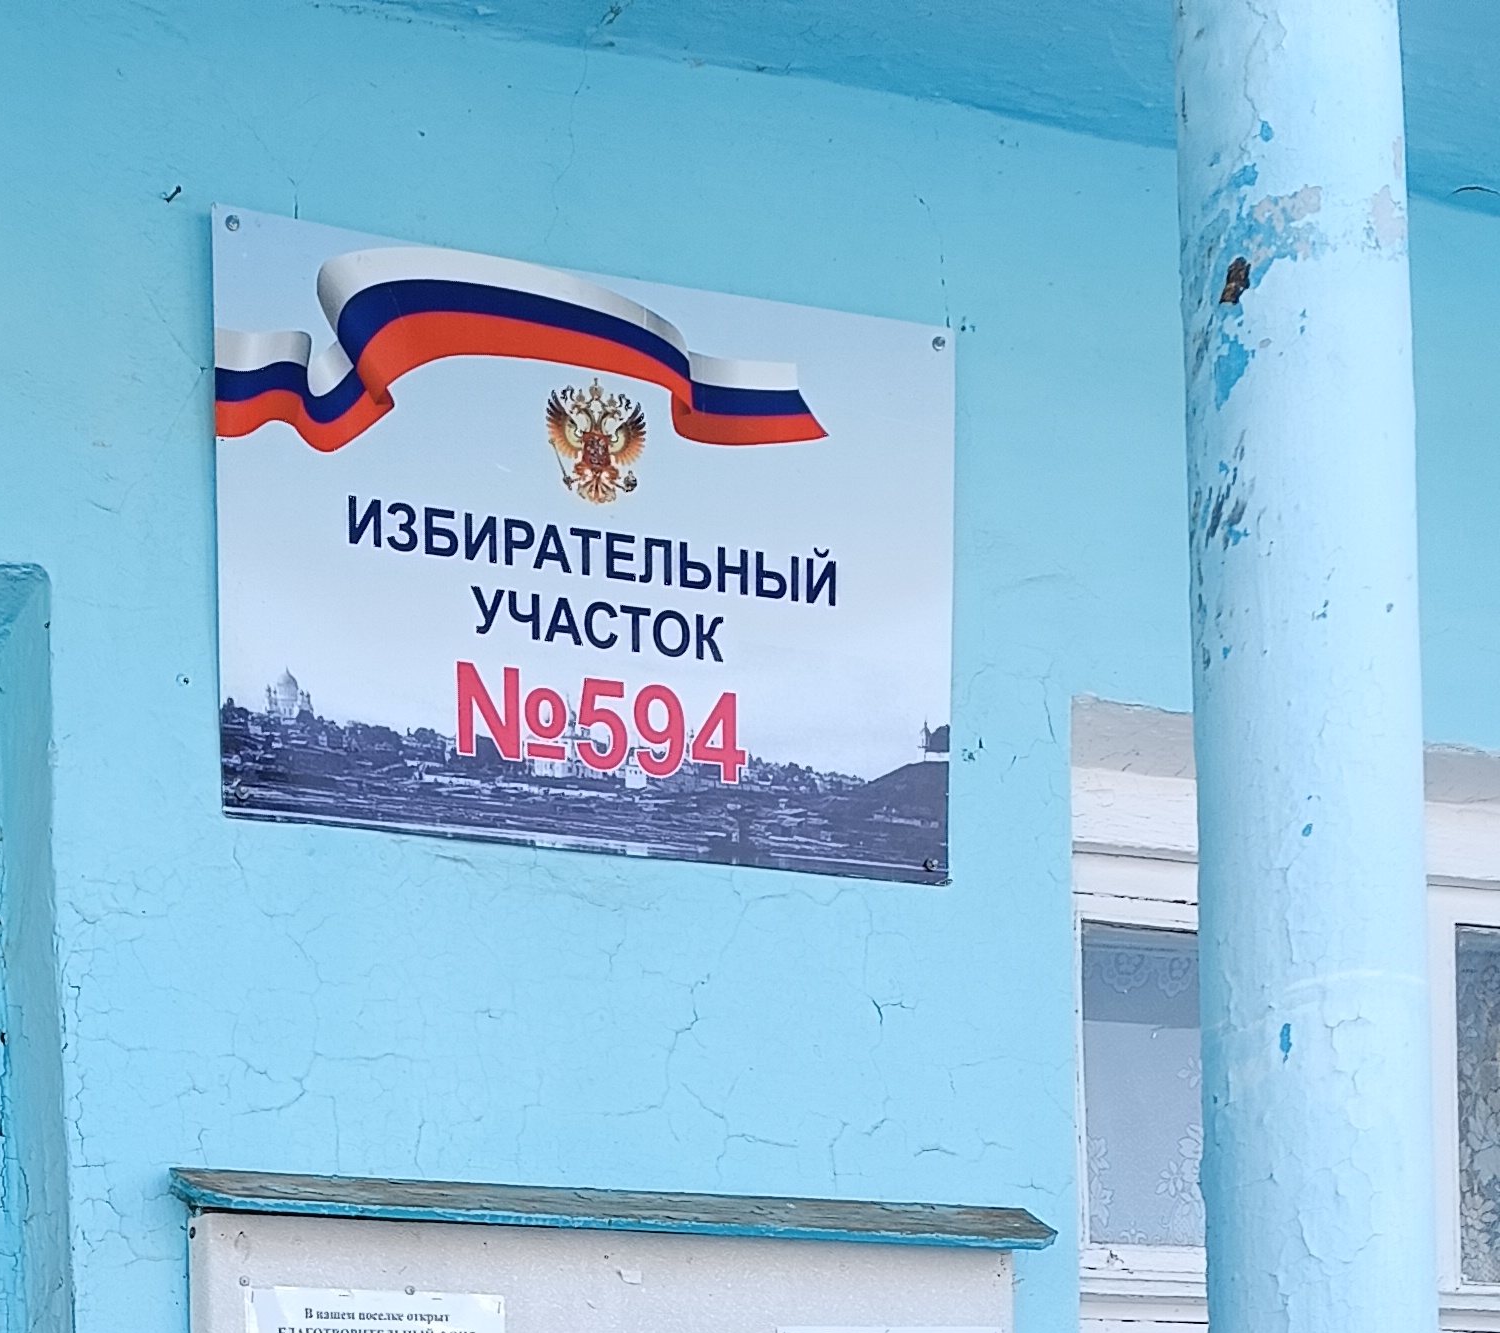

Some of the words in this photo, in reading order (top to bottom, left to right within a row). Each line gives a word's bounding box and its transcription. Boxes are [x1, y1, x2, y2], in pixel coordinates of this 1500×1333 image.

[348, 494, 838, 608] ИЗБИРАТЕЛЬНЫЙ
[471, 586, 724, 661] УЧАСТОК
[456, 661, 747, 784] №594
[305, 1308, 313, 1319] В
[316, 1311, 355, 1320] нашем
[359, 1312, 403, 1322] поселке
[407, 1313, 450, 1324] открыт
